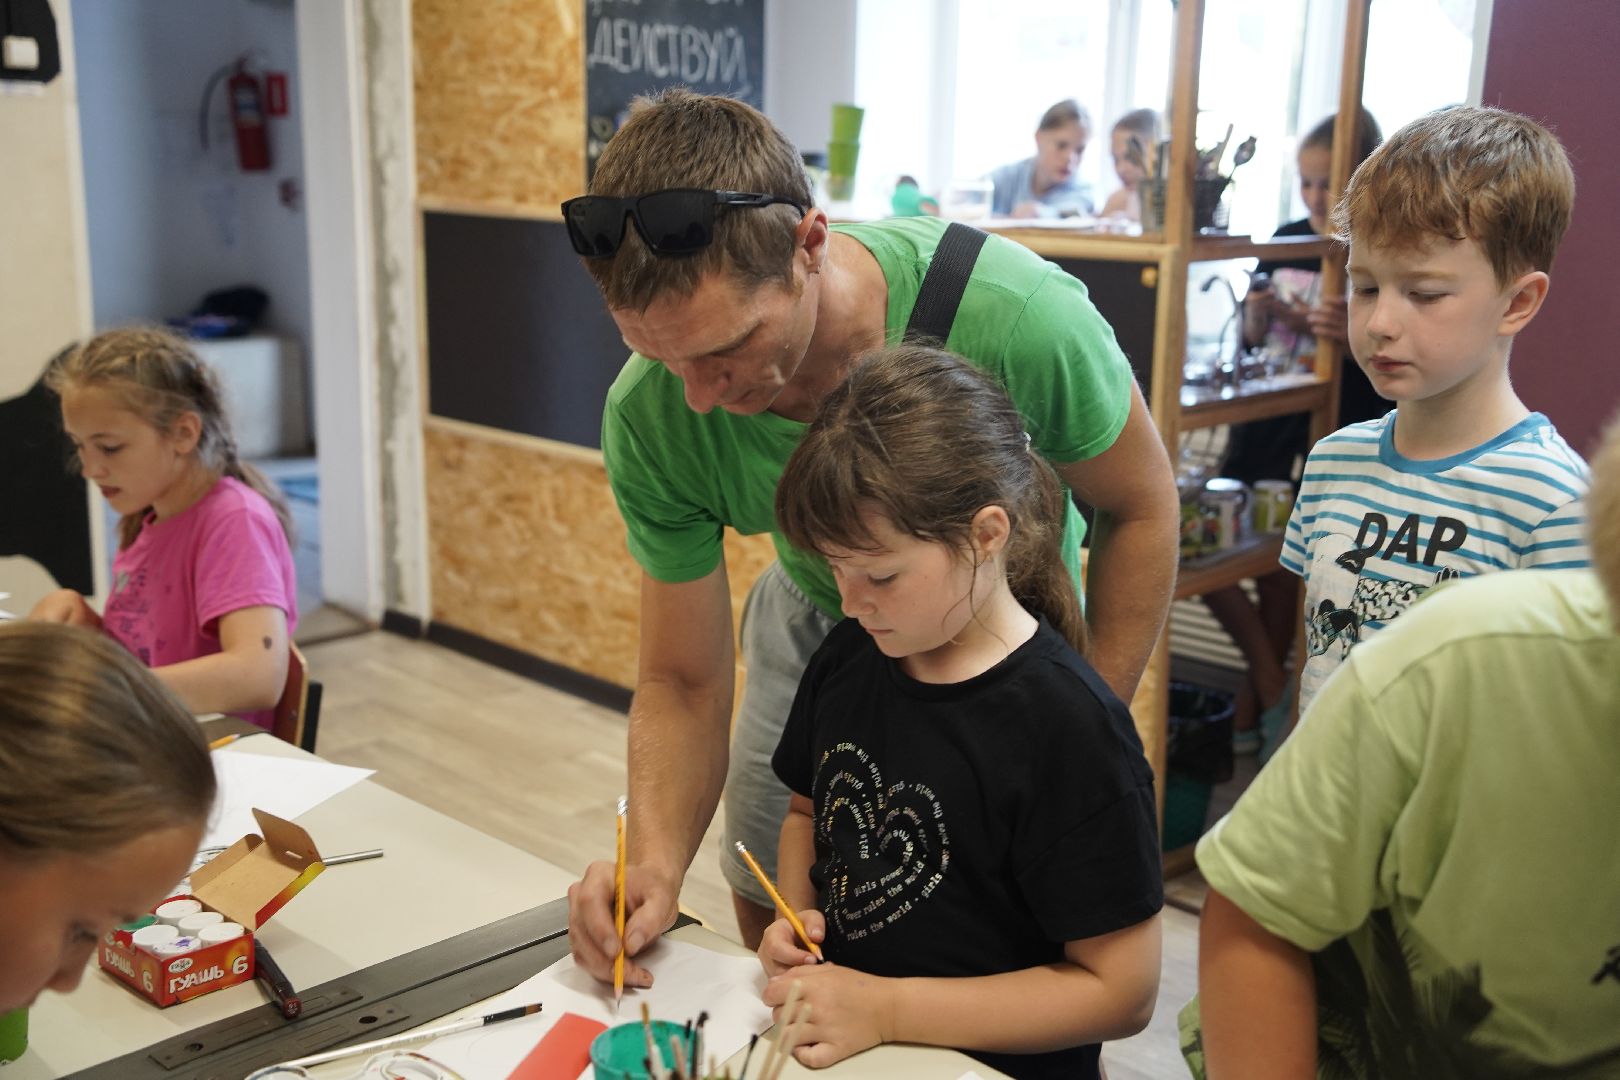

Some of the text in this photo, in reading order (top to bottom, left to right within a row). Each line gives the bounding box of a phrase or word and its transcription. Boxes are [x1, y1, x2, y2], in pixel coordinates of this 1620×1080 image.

[1354, 512, 1467, 567] DAP
[849, 803, 867, 830] power
[854, 881, 877, 897] girls
[863, 896, 886, 915] rules
[886, 884, 903, 897] the
[921, 872, 943, 898] girls
[847, 928, 868, 940] rules
[870, 921, 884, 932] the
[886, 900, 912, 923] world
[142, 970, 153, 993] 6
[169, 956, 248, 994] ГУАШЬ 6
